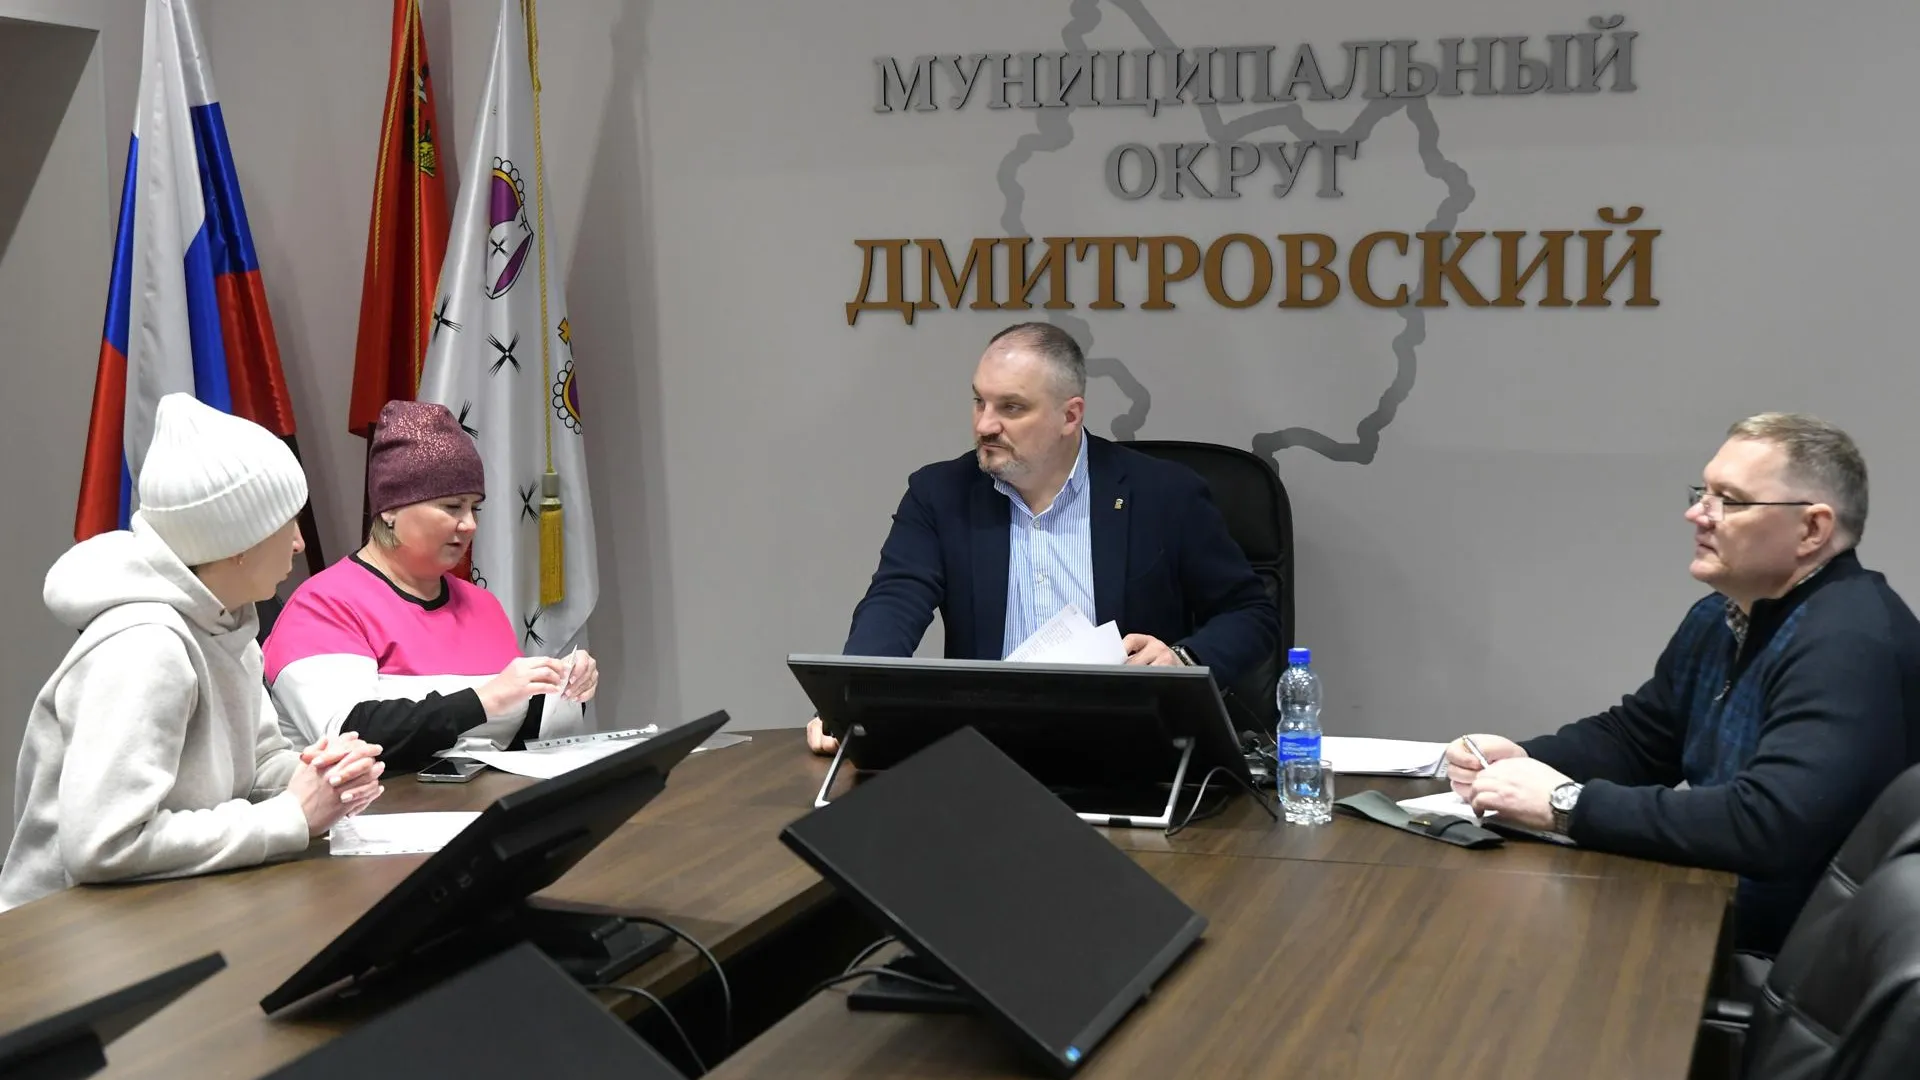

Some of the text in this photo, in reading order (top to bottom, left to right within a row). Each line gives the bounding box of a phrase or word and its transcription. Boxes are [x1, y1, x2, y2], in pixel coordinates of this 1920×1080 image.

[875, 14, 1639, 117] МУНИЦИПАЛЬНЫЙ
[1105, 139, 1359, 200] ОКРУГ
[846, 206, 1661, 325] ДМИТРОВСКИЙ
